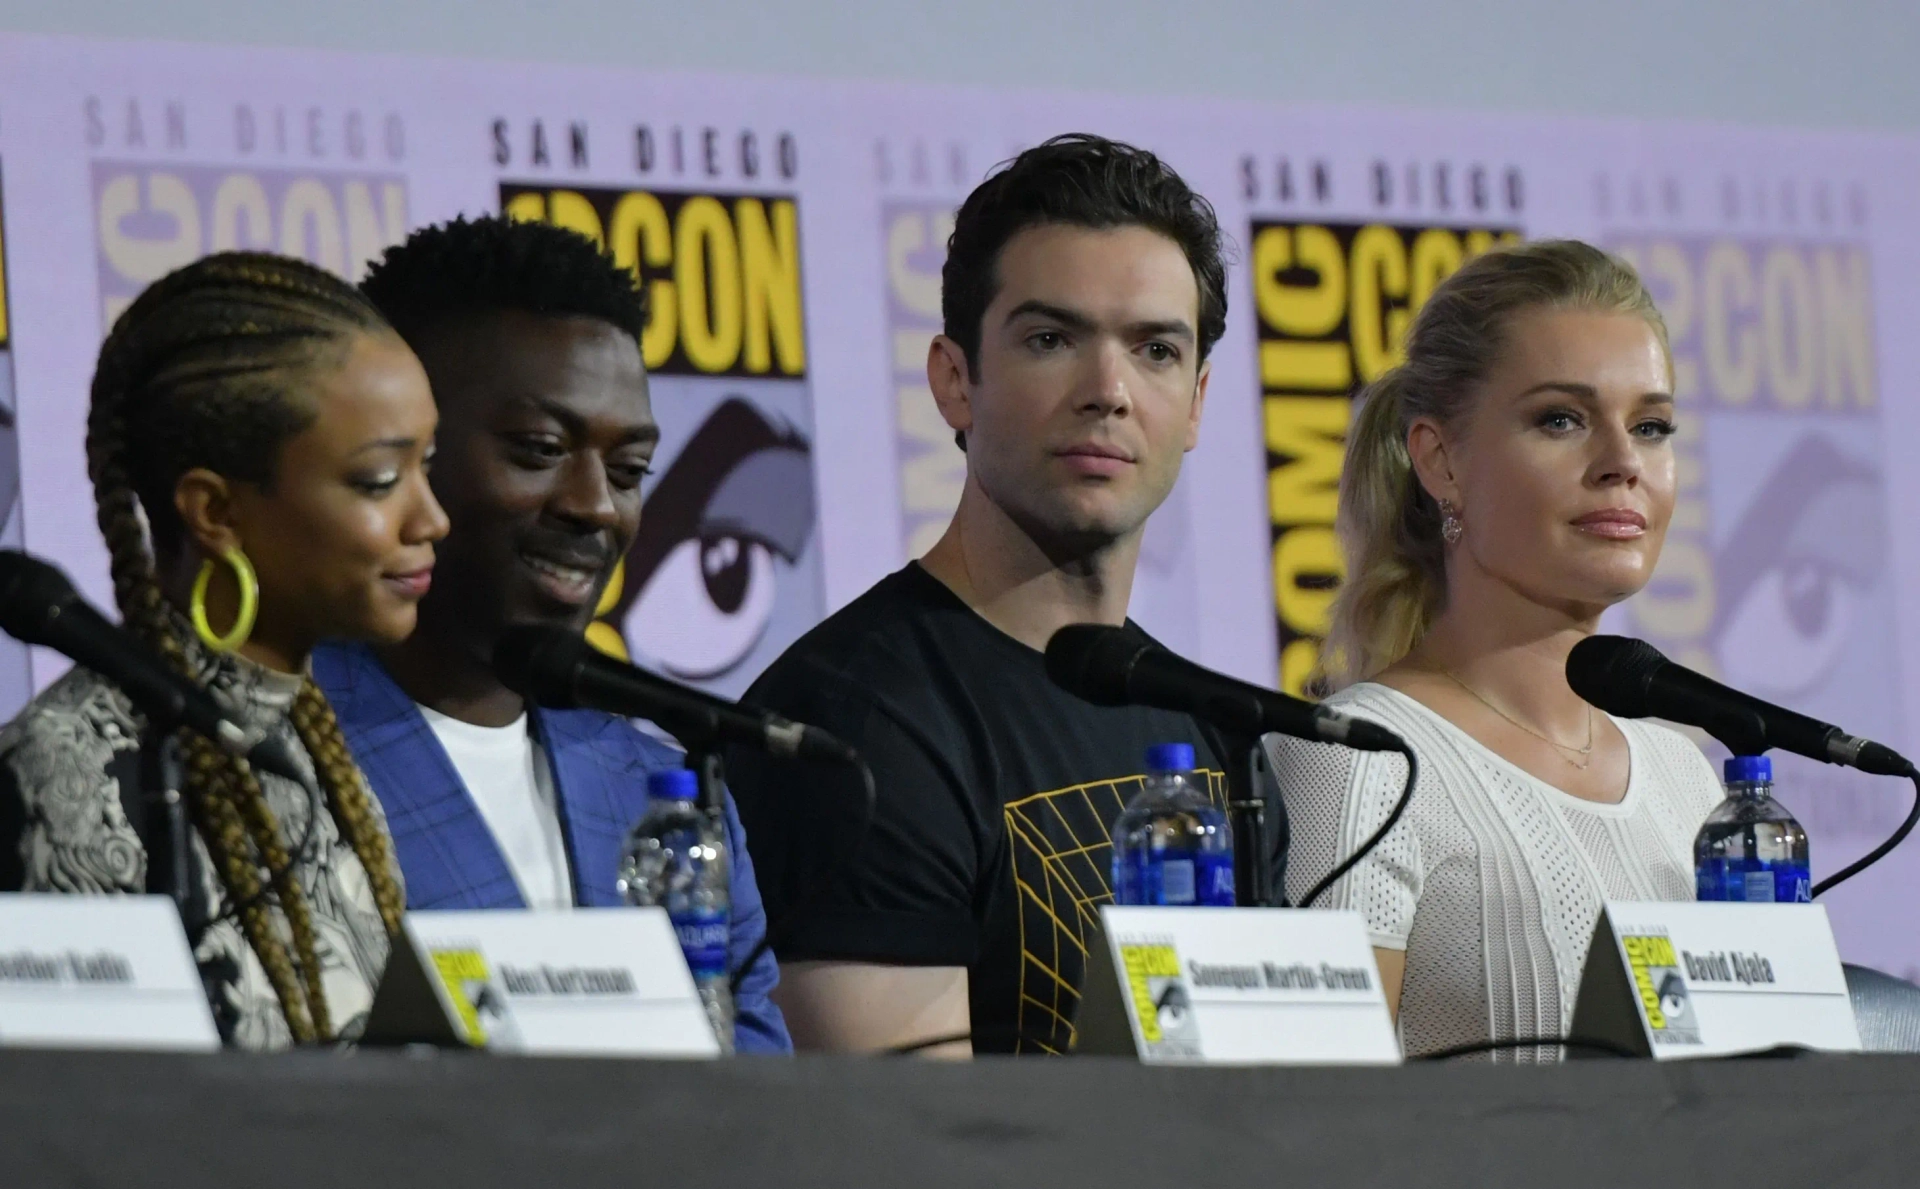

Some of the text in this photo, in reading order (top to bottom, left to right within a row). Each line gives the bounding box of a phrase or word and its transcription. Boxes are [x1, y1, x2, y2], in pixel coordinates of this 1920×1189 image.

[84, 97, 405, 158] SAN DIEGO
[491, 118, 798, 182] SAN DIEGO
[1240, 156, 1526, 211] SAN DIEGO
[609, 190, 804, 374] CON
[1703, 240, 1877, 408] CON
[1683, 951, 1776, 985] David Ajala
